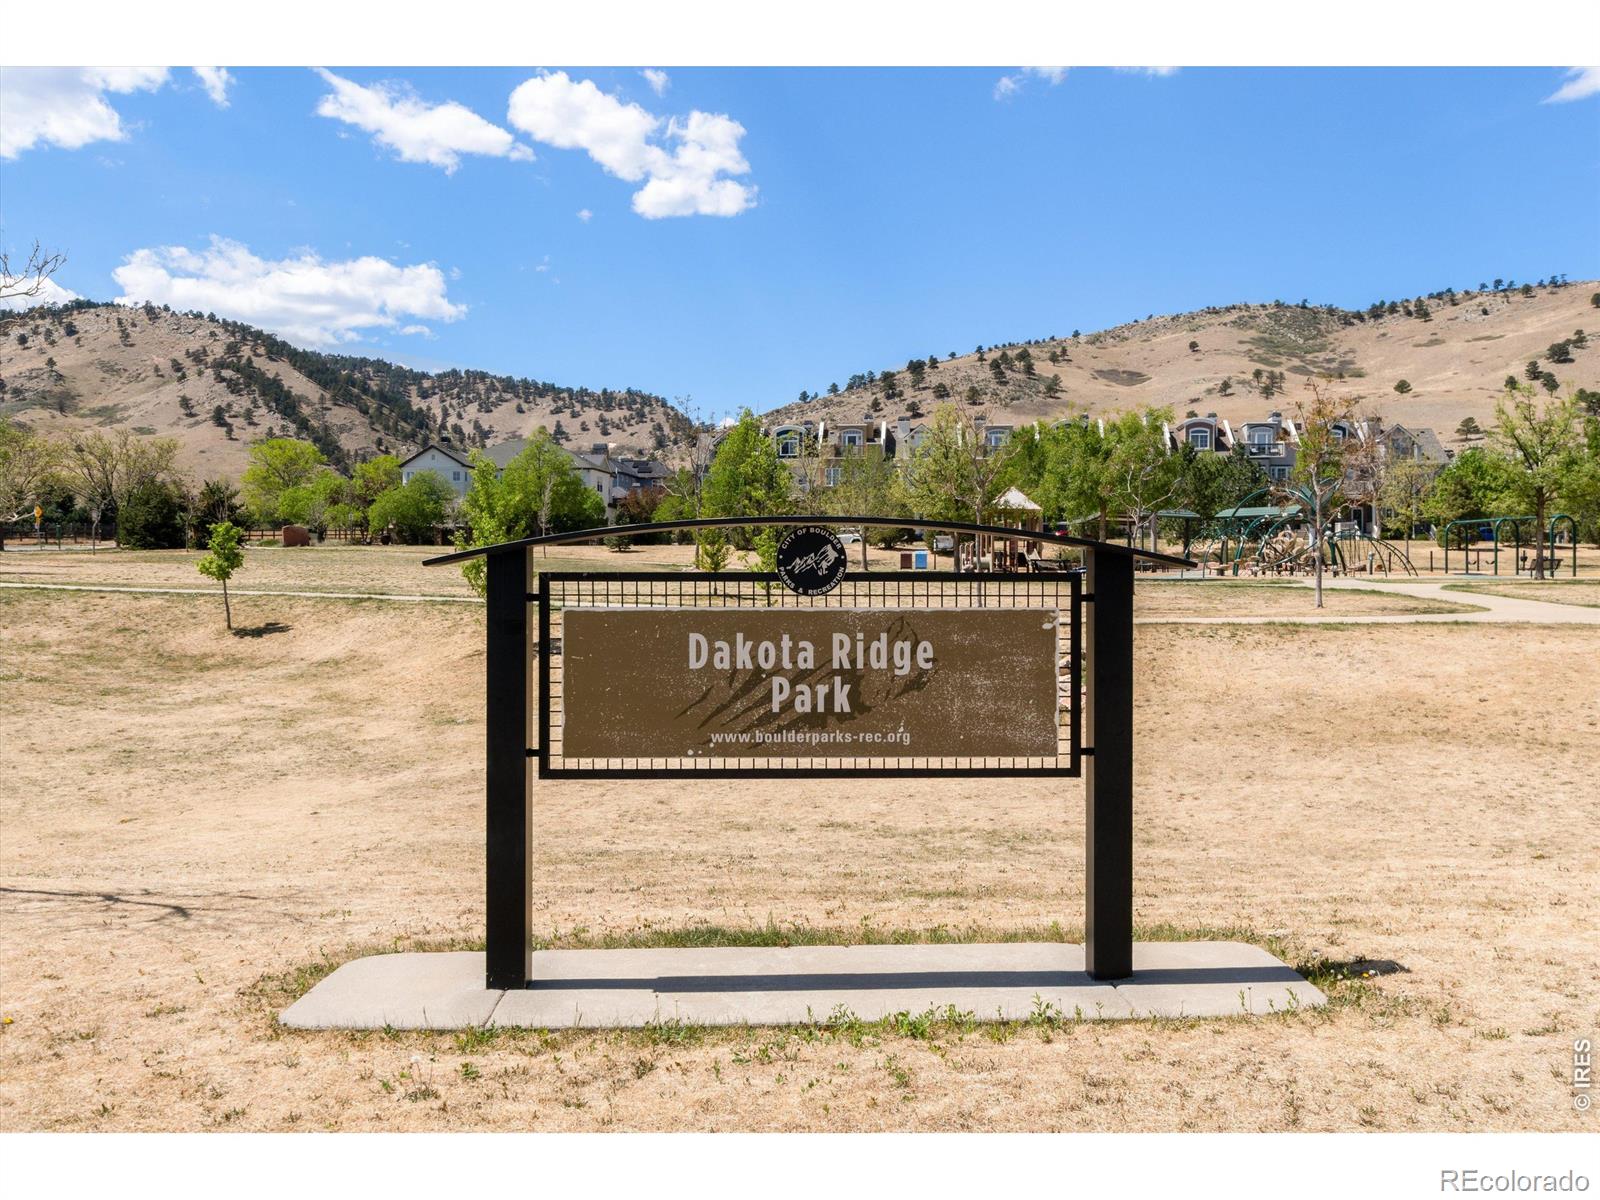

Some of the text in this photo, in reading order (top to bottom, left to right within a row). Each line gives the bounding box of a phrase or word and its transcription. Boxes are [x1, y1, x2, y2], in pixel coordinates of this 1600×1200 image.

[781, 527, 842, 550] CITY OF BOULDER
[779, 566, 796, 589] PARKS
[808, 566, 845, 595] RECREATION
[688, 632, 934, 676] Dakota Ridge
[772, 676, 852, 713] Park
[711, 730, 911, 746] www.boulderparks-rec.org
